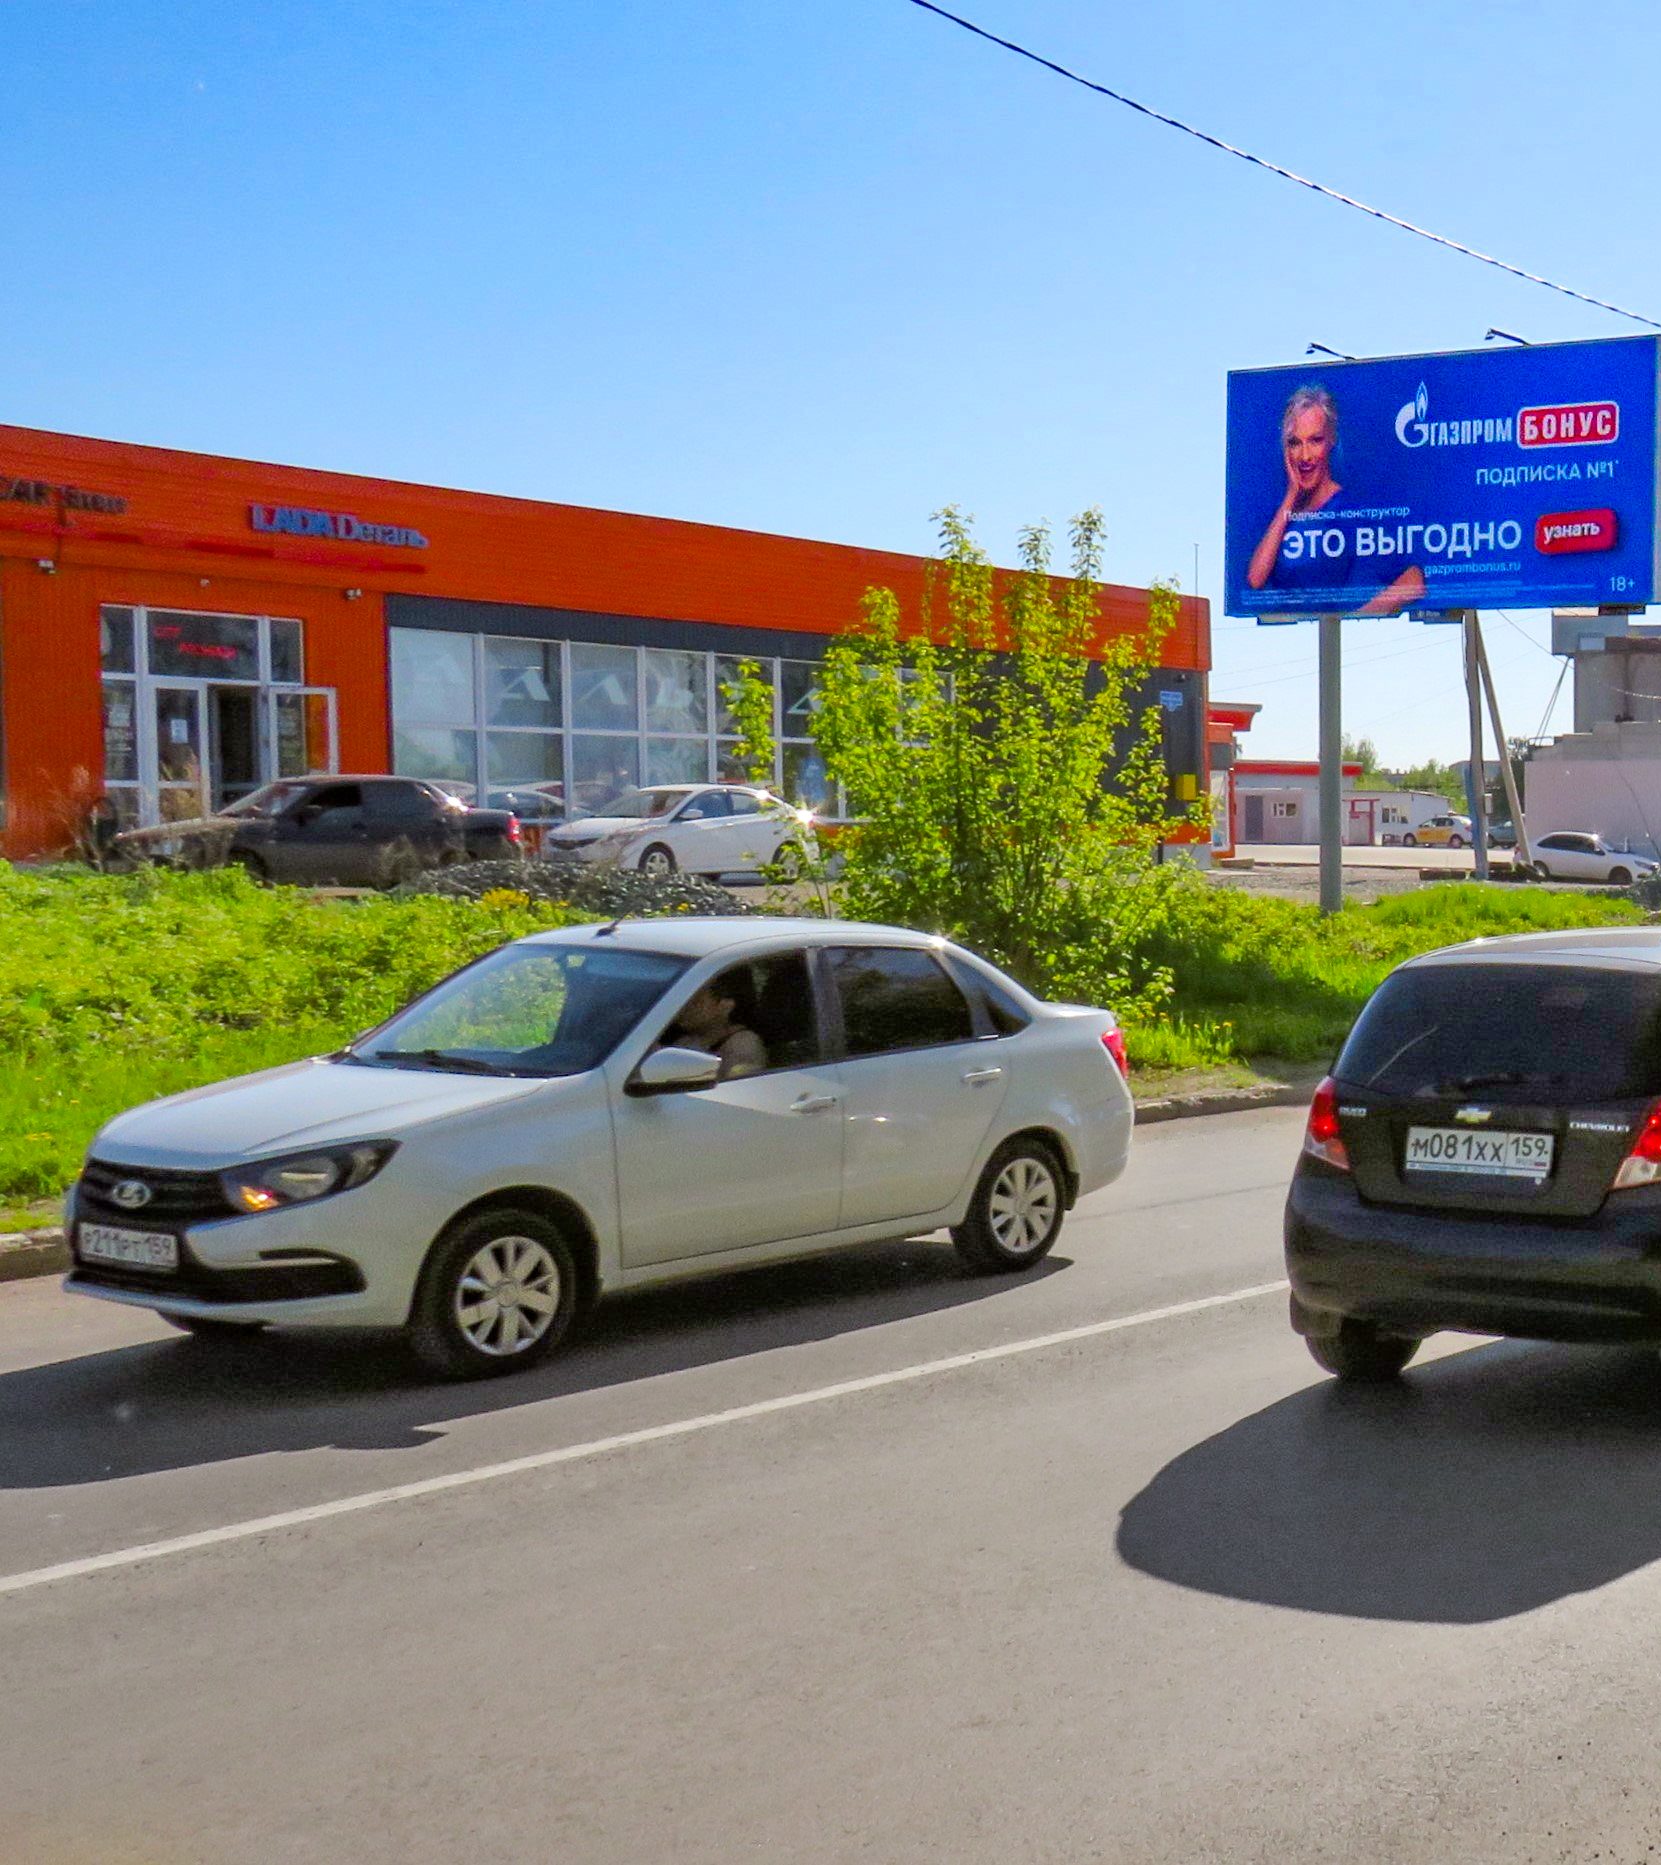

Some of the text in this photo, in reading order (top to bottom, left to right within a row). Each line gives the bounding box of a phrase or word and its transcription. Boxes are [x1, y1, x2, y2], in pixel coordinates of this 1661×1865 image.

[1429, 409, 1612, 447] ГАЗПРОМ БОНУС
[1475, 462, 1582, 487] ПОДПИСКА
[252, 502, 334, 538] LADA
[1283, 506, 1411, 523] Подписка-конструктор
[1282, 519, 1523, 560] ЭТО ВЫГОДНО
[1543, 522, 1601, 545] узнать
[1423, 560, 1521, 579] gazprombonus.ru
[1608, 576, 1636, 592] 18+
